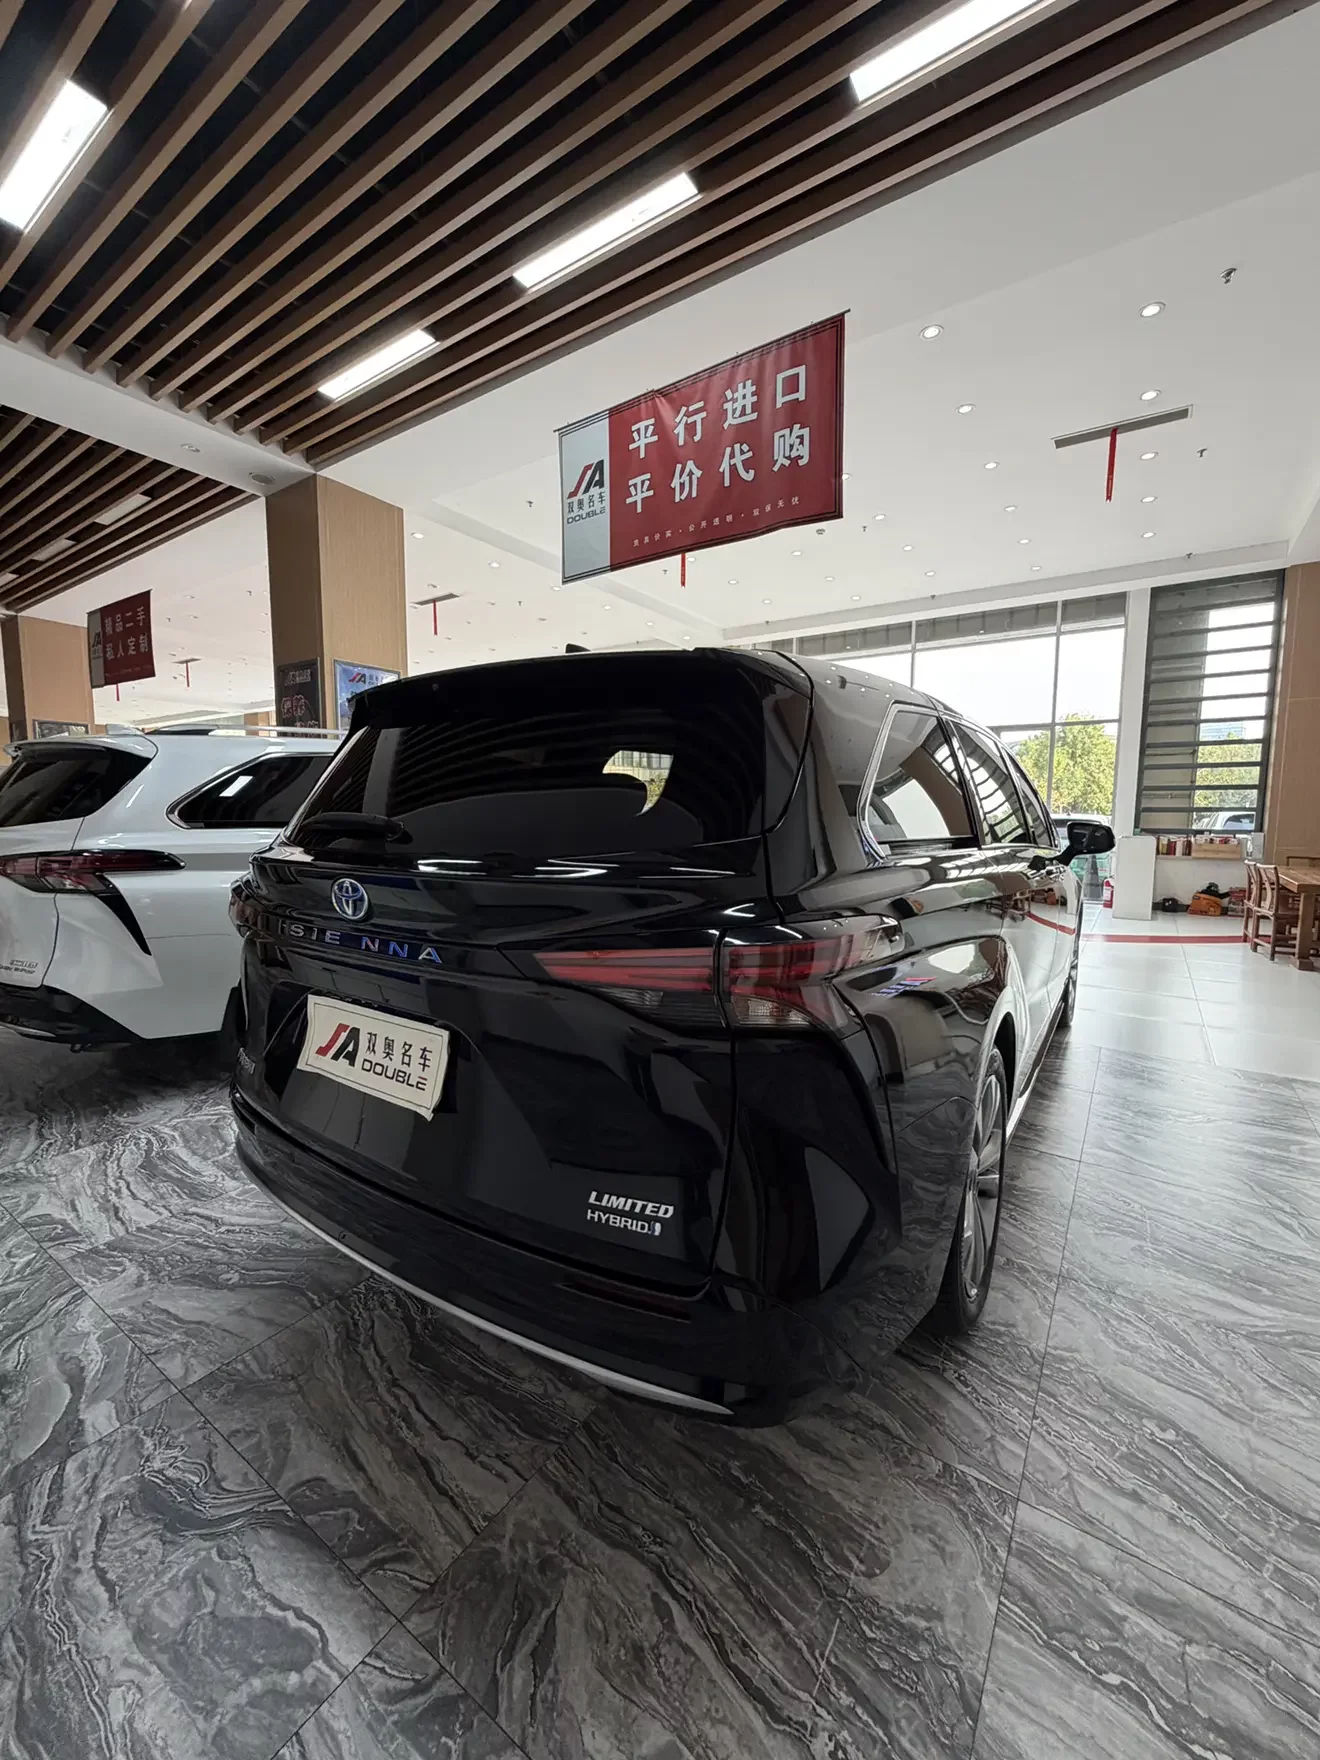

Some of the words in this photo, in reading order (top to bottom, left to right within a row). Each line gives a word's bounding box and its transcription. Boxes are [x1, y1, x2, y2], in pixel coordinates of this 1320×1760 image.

[628, 364, 807, 459] 平行进口
[625, 423, 811, 513] 平价代购
[566, 506, 606, 524] DOUBLE
[290, 924, 443, 964] SIENNA
[365, 1031, 433, 1073] 双奥名车
[361, 1058, 428, 1092] DOUBLE
[586, 1208, 649, 1234] HYBRID
[588, 1190, 675, 1219] LIMITED
